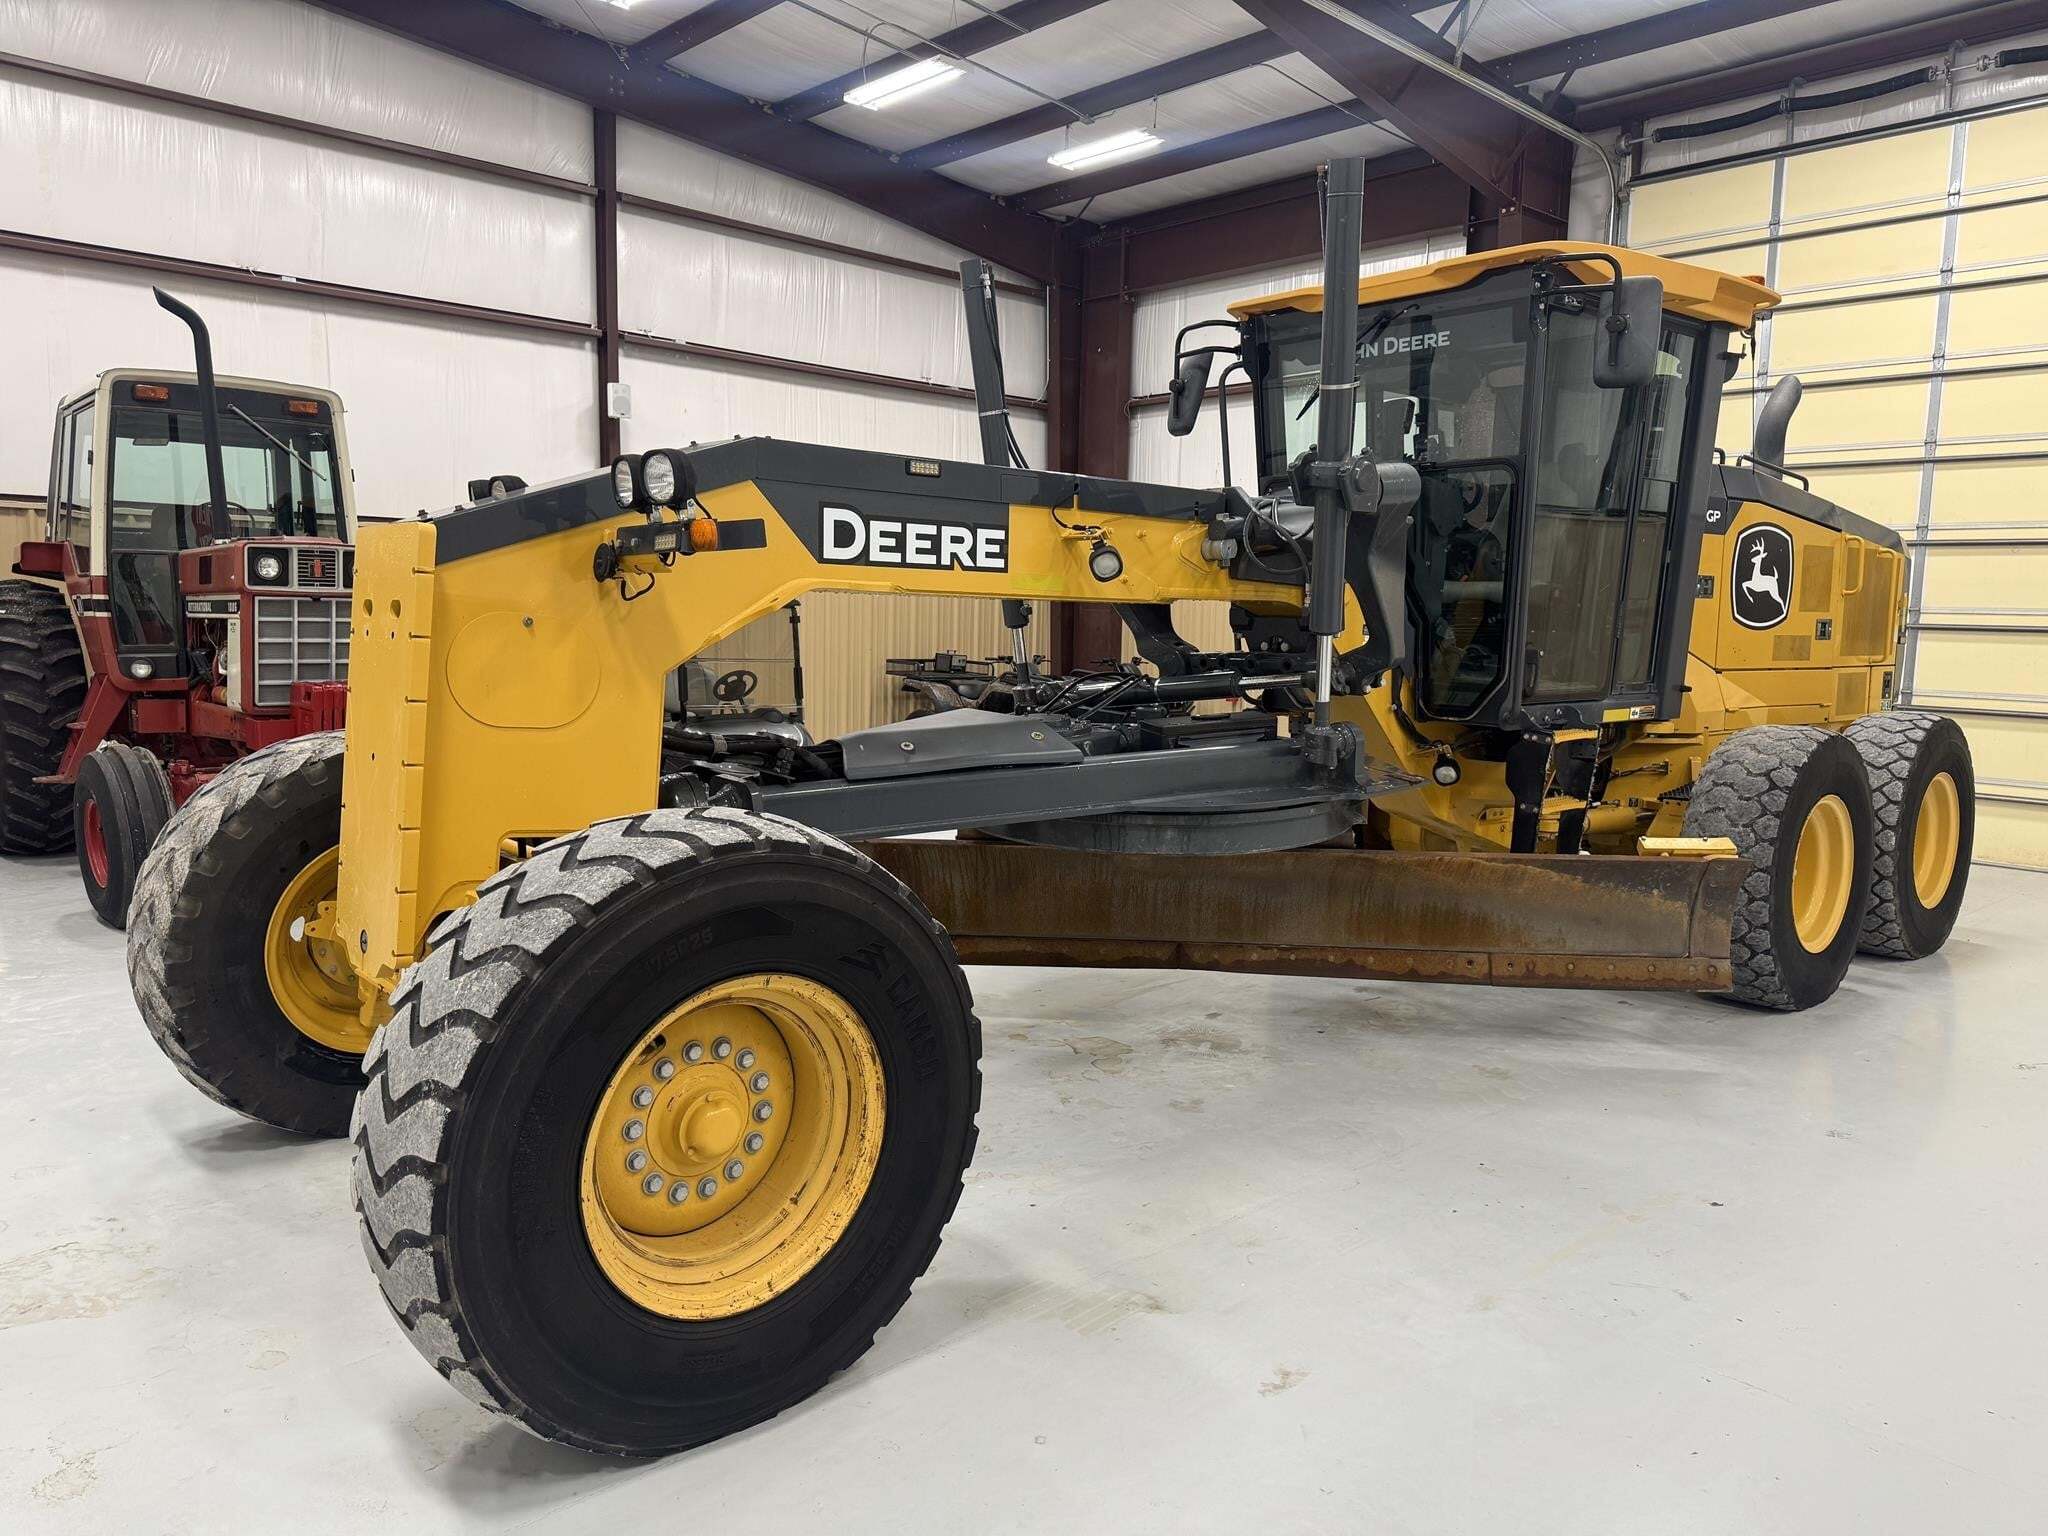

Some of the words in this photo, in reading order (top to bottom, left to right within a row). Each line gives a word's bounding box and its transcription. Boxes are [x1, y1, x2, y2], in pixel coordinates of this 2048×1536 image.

[1356, 342, 1379, 359] HN
[1383, 330, 1451, 355] DEERE
[1706, 509, 1721, 523] GP
[823, 507, 1006, 568] DEERE
